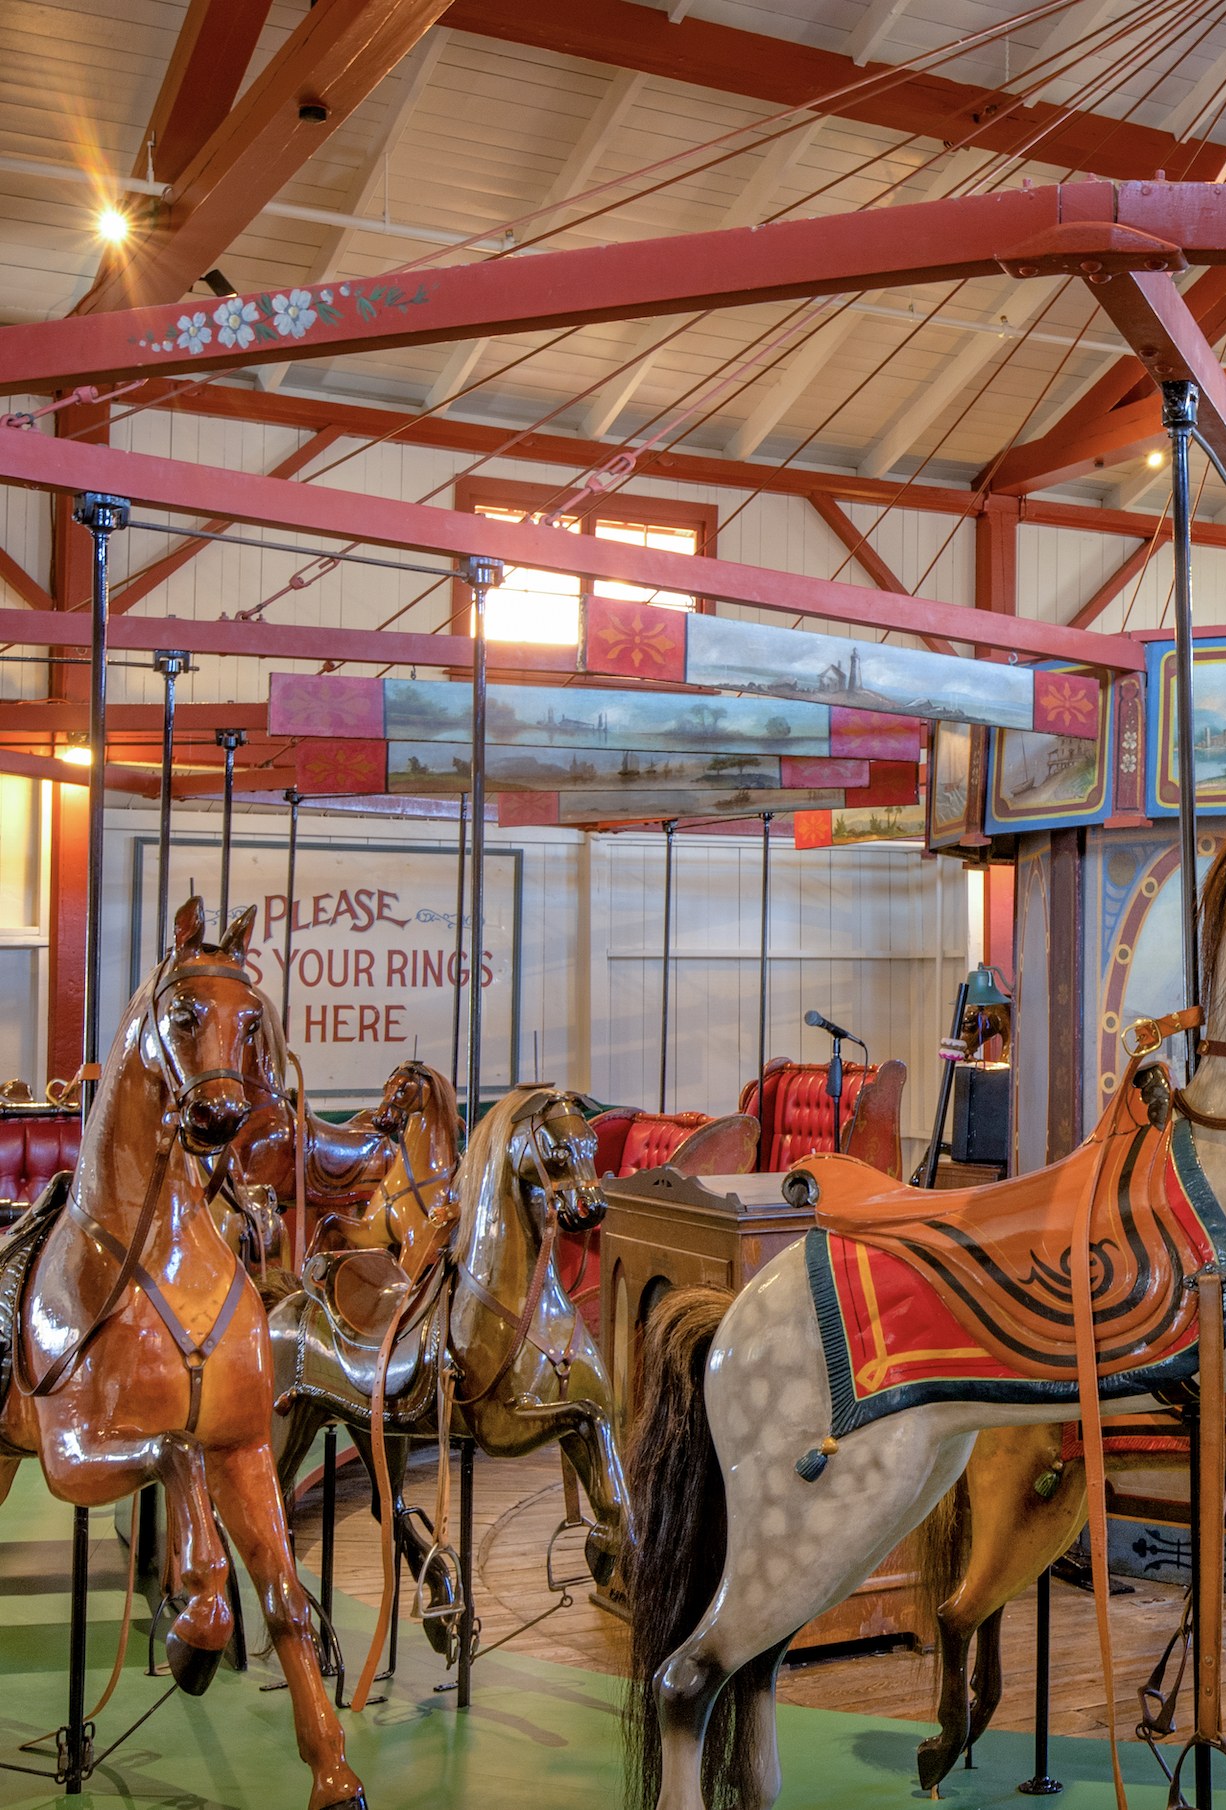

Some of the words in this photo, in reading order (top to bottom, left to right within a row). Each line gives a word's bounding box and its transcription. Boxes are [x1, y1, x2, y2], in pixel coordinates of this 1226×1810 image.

[263, 889, 412, 943] PLEASE
[272, 948, 375, 988] YOUR
[387, 949, 494, 988] RINGS
[305, 1004, 408, 1043] HERE
